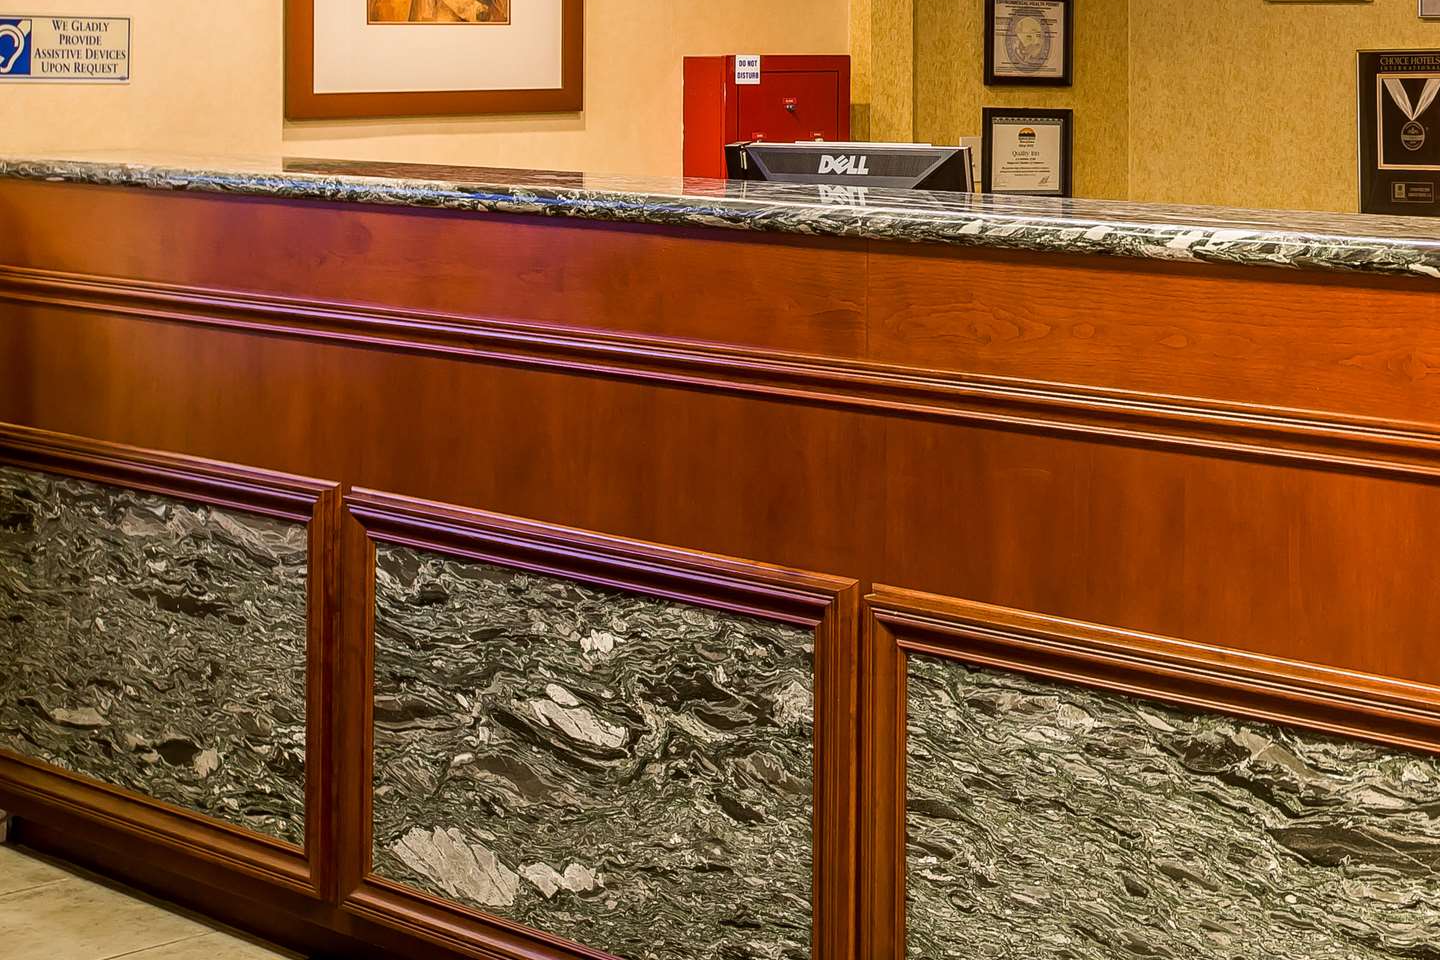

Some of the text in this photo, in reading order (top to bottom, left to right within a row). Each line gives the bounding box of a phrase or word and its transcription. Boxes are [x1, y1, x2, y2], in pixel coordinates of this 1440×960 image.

[52, 20, 109, 32] WE GLADLY
[60, 34, 102, 46] PROVIDE
[34, 48, 126, 60] ASSISTIVE DEVICES
[1380, 57, 1409, 65] CHOICE
[41, 62, 118, 75] UPON REQUEST
[818, 154, 870, 175] DELL
